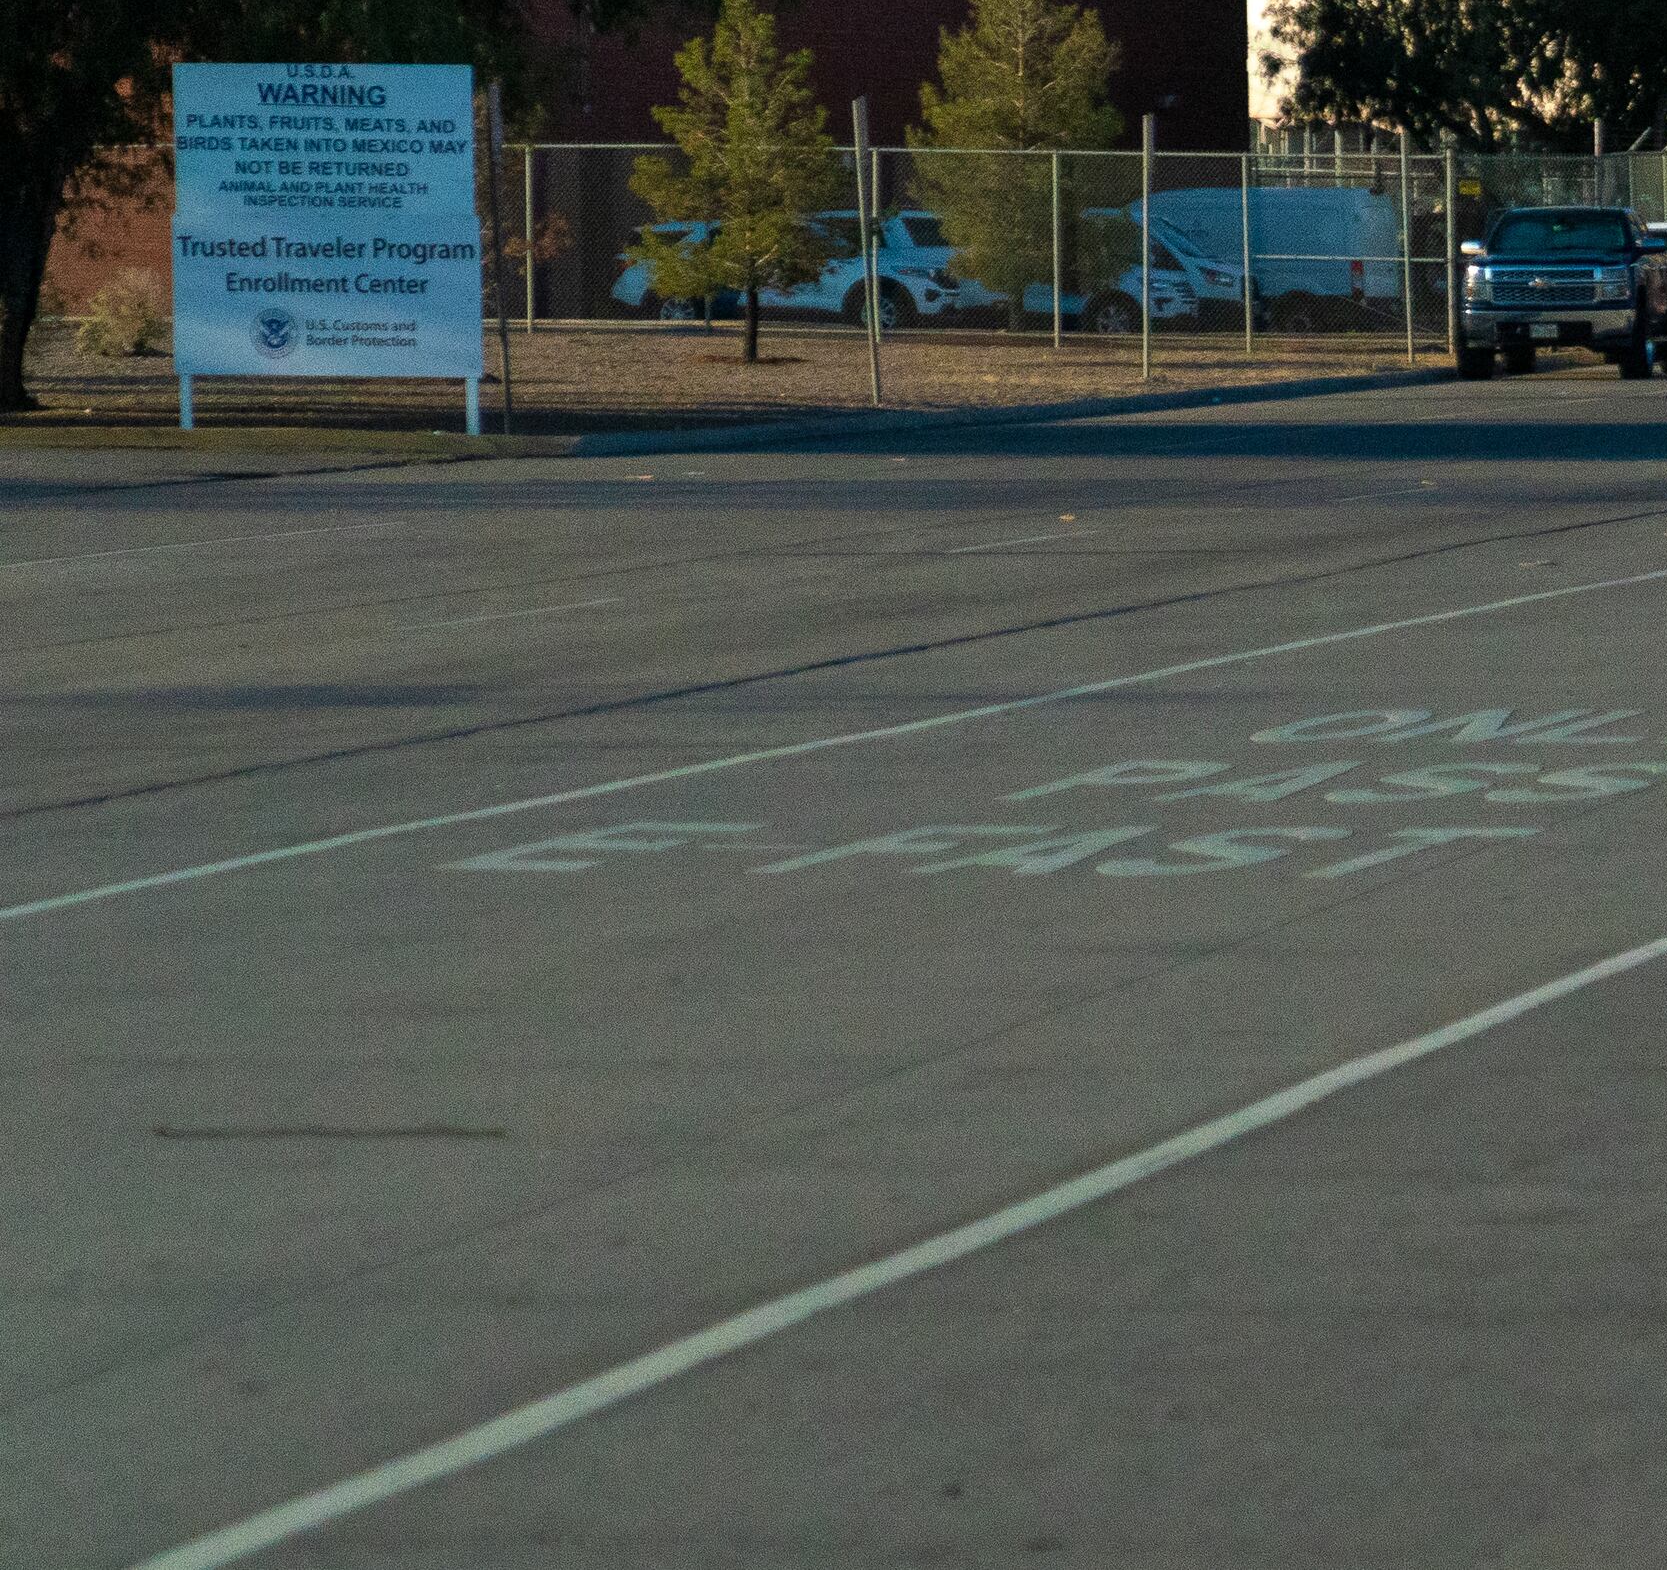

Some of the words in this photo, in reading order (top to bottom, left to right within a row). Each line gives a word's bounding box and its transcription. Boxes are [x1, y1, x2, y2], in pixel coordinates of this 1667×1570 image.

[257, 83, 386, 106] WARNING
[186, 114, 263, 130] PLANTS,
[269, 115, 339, 131] FRUITS,
[416, 119, 457, 133] AND
[177, 136, 231, 151] BIRDS
[234, 137, 299, 152] TAKEN
[303, 138, 350, 152] INTO
[352, 139, 424, 154] MEXICO
[429, 140, 468, 155] MAY
[234, 160, 270, 175] NOT
[279, 160, 303, 175] BE
[308, 161, 409, 177] RETURNED
[219, 181, 278, 192] ANIMAL
[281, 181, 310, 193] AND
[315, 182, 364, 194] PLANT
[368, 182, 429, 195] HEALTH
[243, 195, 335, 207] INSPECTION
[338, 196, 403, 208] SERVICE
[177, 235, 268, 259] Trusted
[271, 236, 366, 259] Traveler
[373, 237, 476, 265] Program
[225, 271, 350, 293] Enrollment
[354, 273, 430, 294] Center
[305, 319, 330, 331] U.S.
[333, 319, 388, 332] Customs
[391, 320, 416, 332] and
[306, 334, 350, 347] Border
[352, 335, 417, 348] Protection
